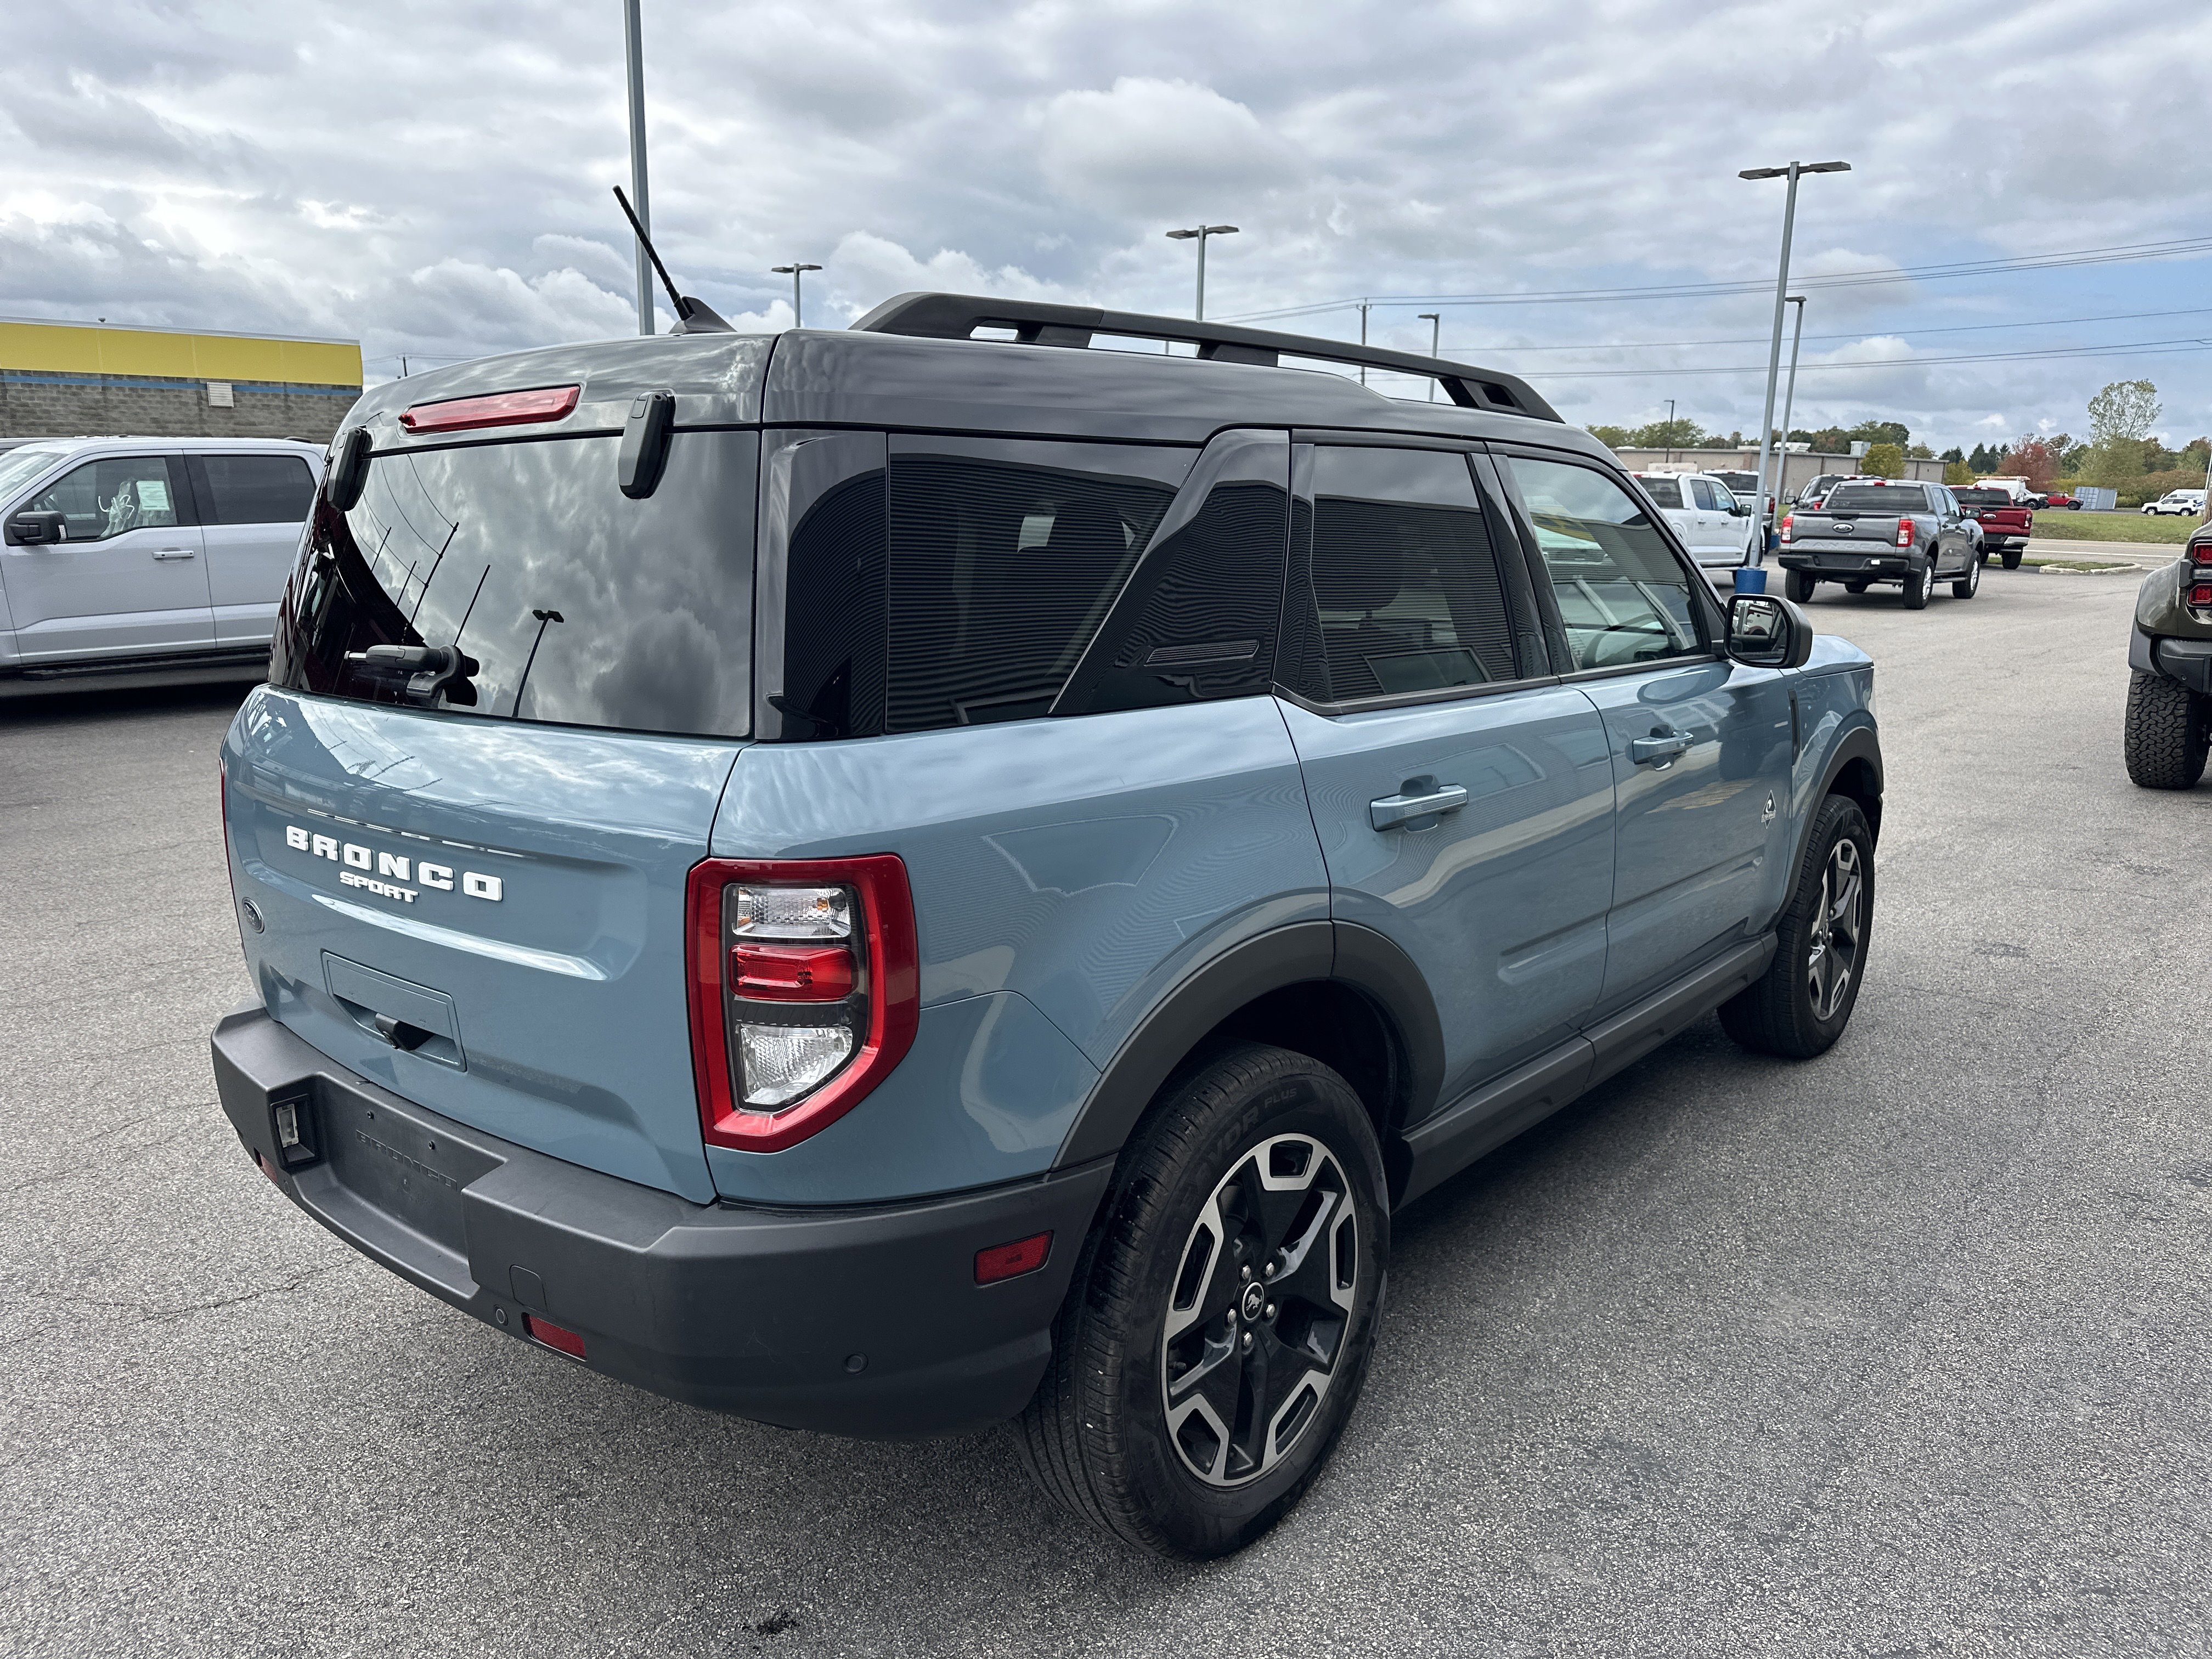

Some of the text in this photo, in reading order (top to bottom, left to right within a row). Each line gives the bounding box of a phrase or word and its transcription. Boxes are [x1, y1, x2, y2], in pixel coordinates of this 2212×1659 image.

[1799, 541, 1887, 551] RANGER
[286, 825, 503, 902] BRONCO
[340, 871, 419, 903] SPORT
[1263, 1087, 1297, 1109] PLUS
[356, 1128, 459, 1193] BRONCO
